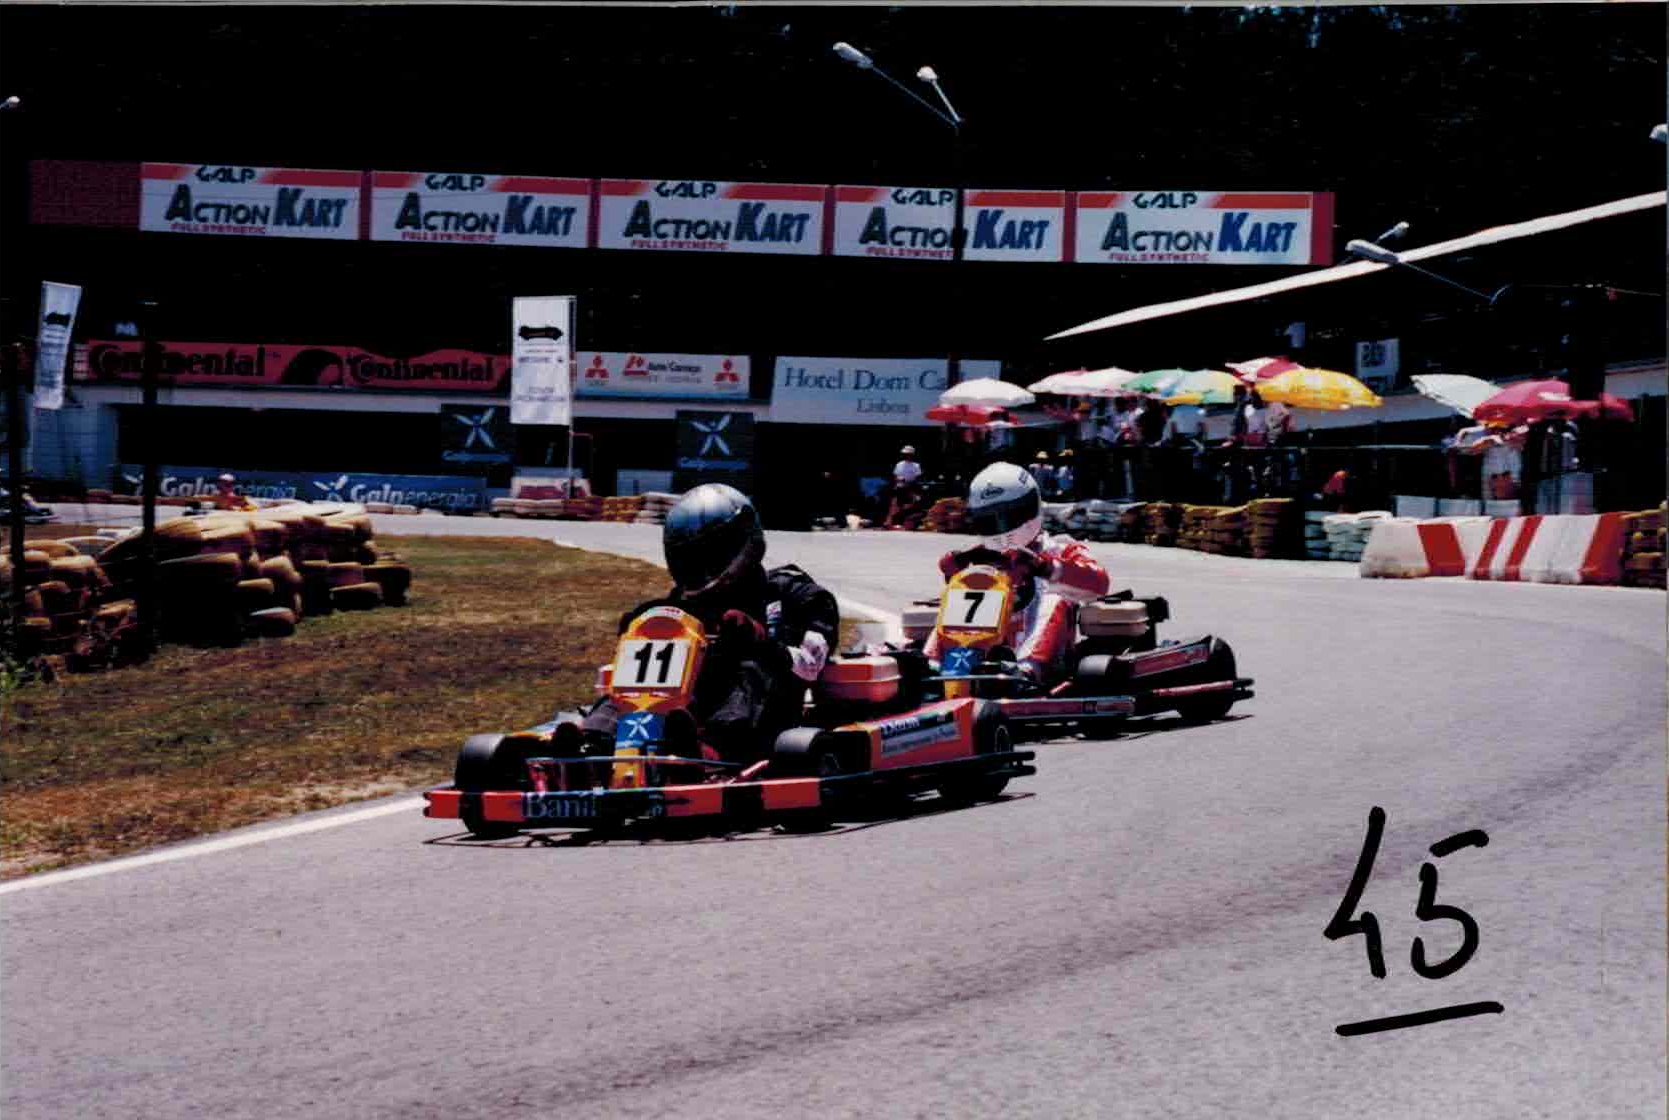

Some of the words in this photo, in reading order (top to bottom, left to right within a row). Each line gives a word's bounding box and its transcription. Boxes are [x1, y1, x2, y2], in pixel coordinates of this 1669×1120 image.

[196, 166, 255, 183] GALP
[425, 174, 484, 191] GALP
[655, 181, 716, 198] GALP
[165, 184, 270, 224] ACTION
[273, 188, 347, 227] KART
[892, 189, 954, 205] GALP
[1133, 192, 1198, 209] GALP
[395, 192, 499, 232] ACTION
[502, 195, 576, 235] KART
[623, 200, 731, 240] ACTION
[734, 202, 810, 242] KART
[973, 209, 1049, 250] KART
[1102, 212, 1214, 251] ACTION
[1217, 212, 1297, 252] KART
[91, 343, 265, 381] Connental
[784, 367, 844, 390] Hotel
[853, 370, 910, 391] Dom
[857, 398, 910, 414] Lisboa
[161, 475, 298, 498] Galpnergia
[965, 592, 985, 623] 7
[634, 642, 674, 683] 11
[1324, 806, 1489, 979] 45
